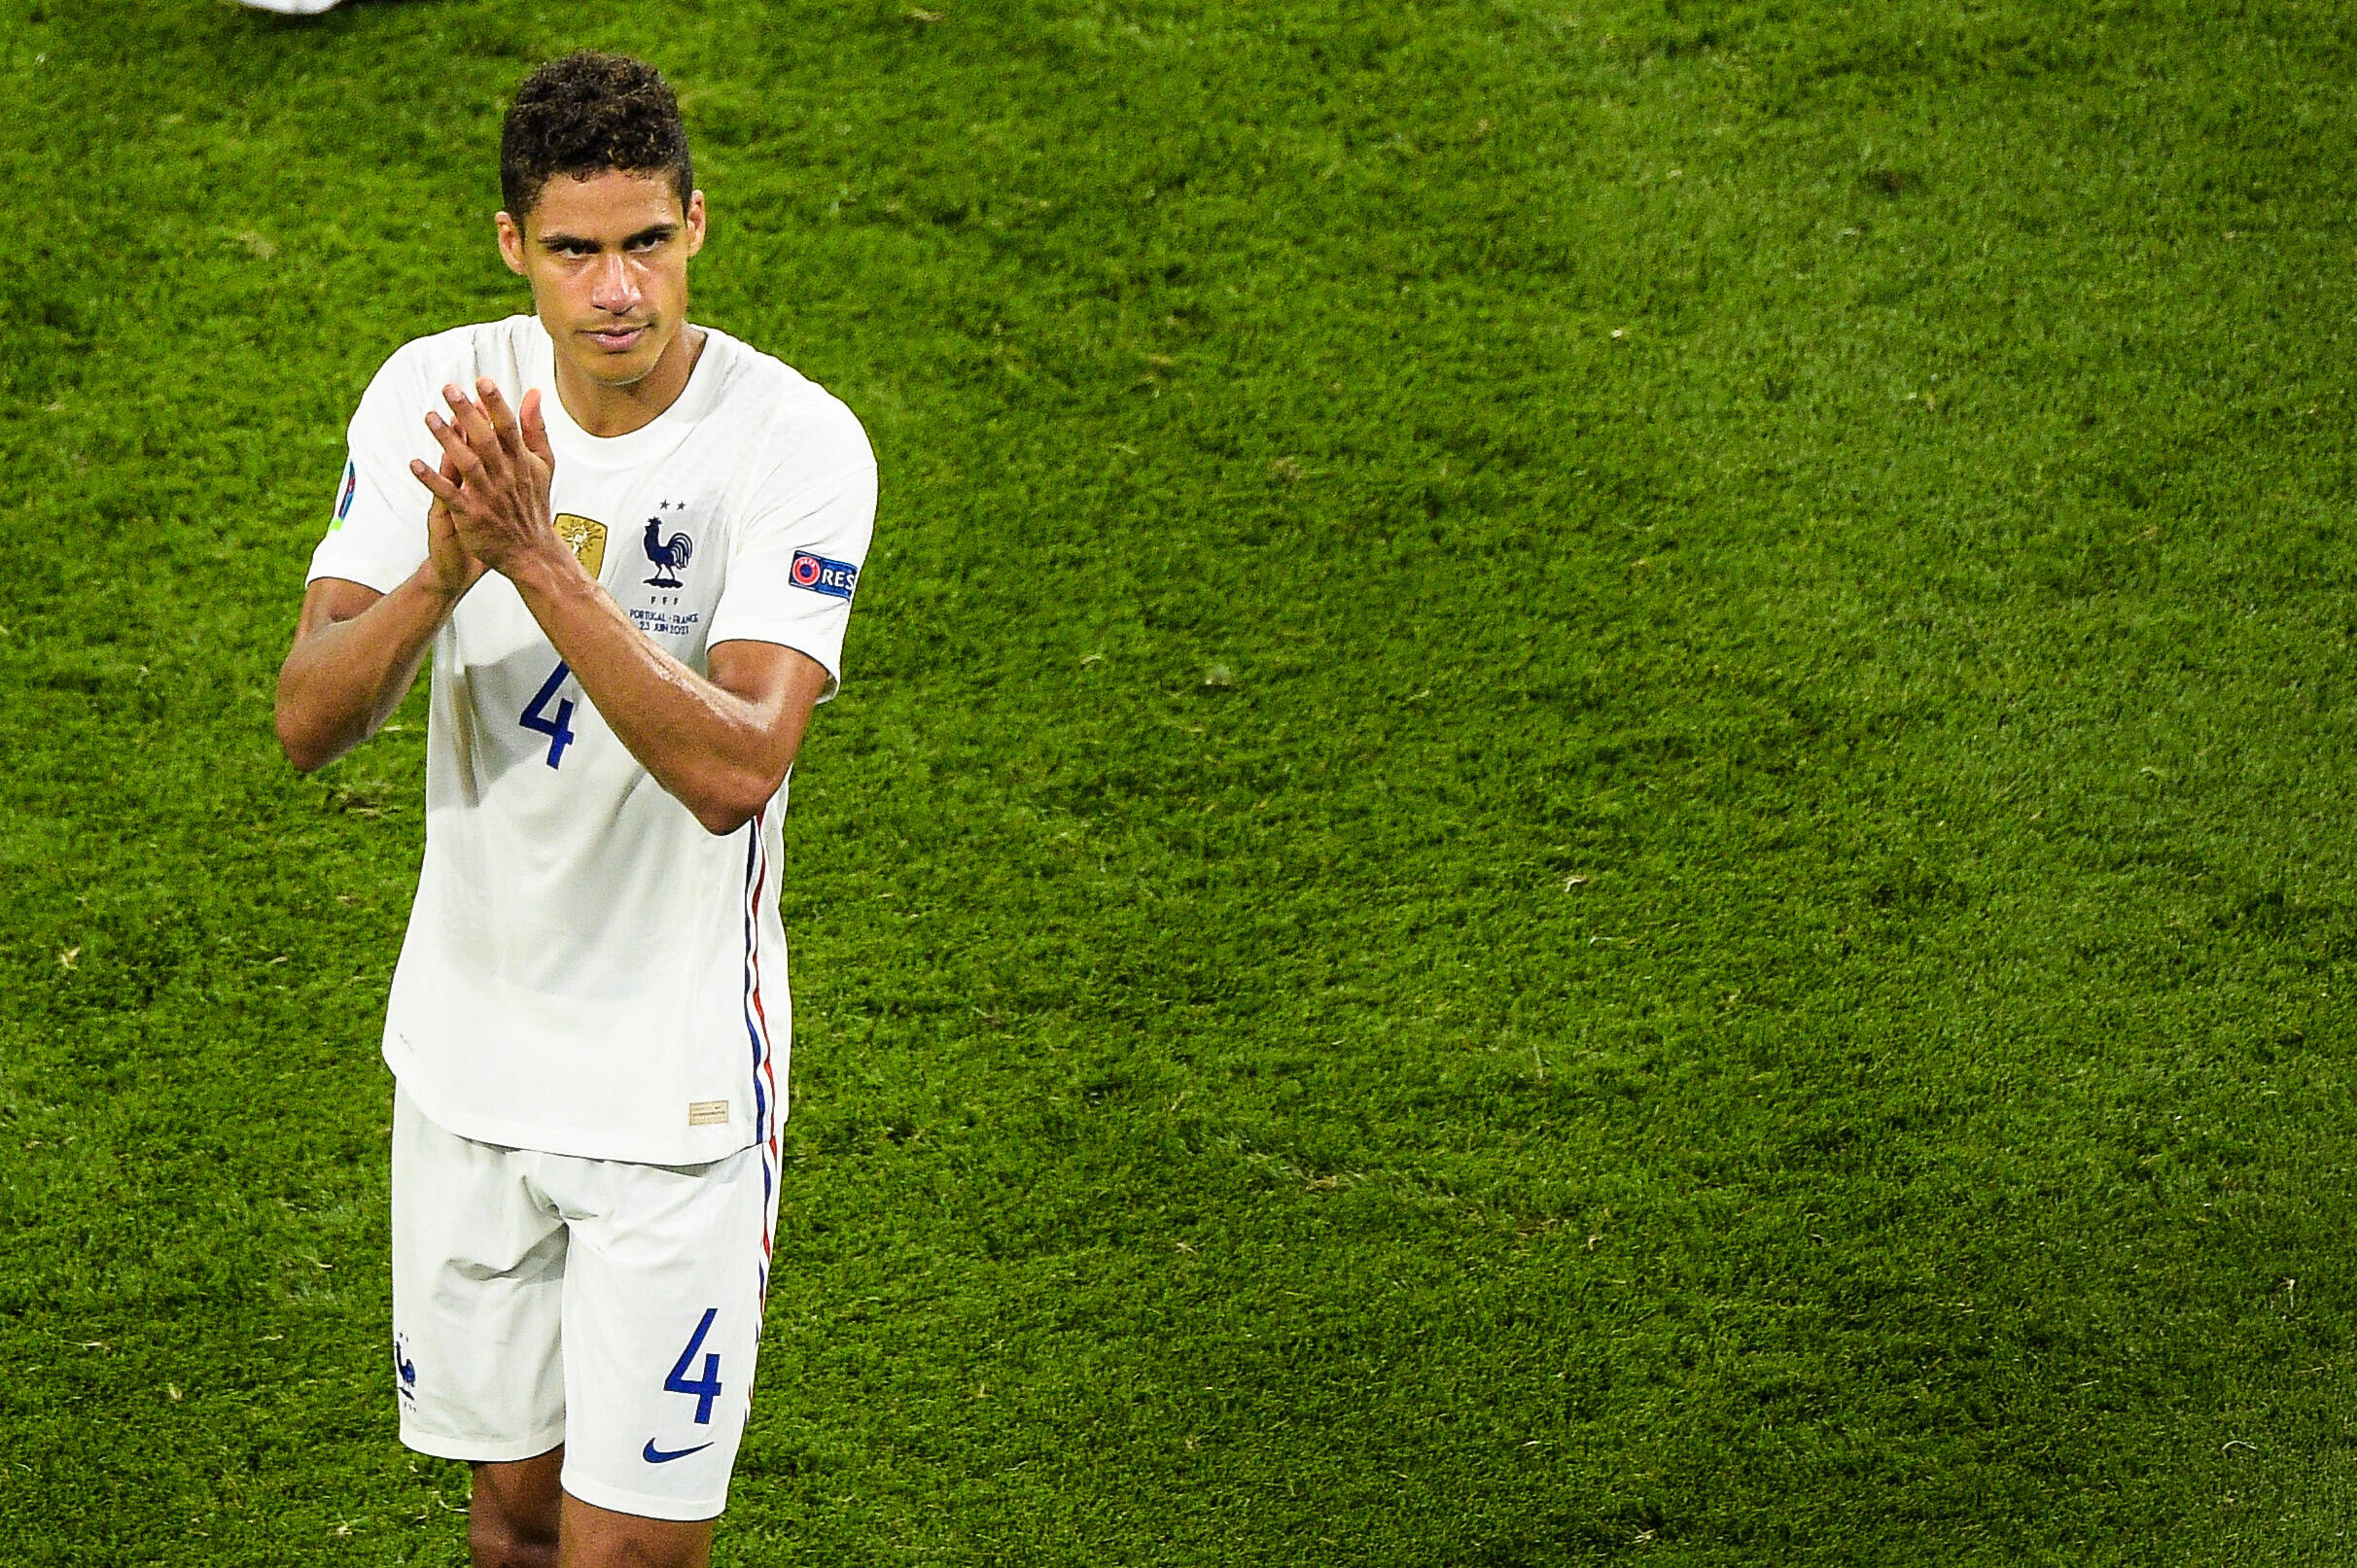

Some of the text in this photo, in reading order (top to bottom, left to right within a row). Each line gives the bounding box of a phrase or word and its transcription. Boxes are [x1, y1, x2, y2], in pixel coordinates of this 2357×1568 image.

[629, 609, 666, 622] PORTUGAL
[673, 613, 699, 624] FRANCE
[639, 620, 651, 631] 23
[653, 623, 669, 632] JUIN
[519, 660, 575, 770] 4
[663, 1307, 722, 1424] 4
